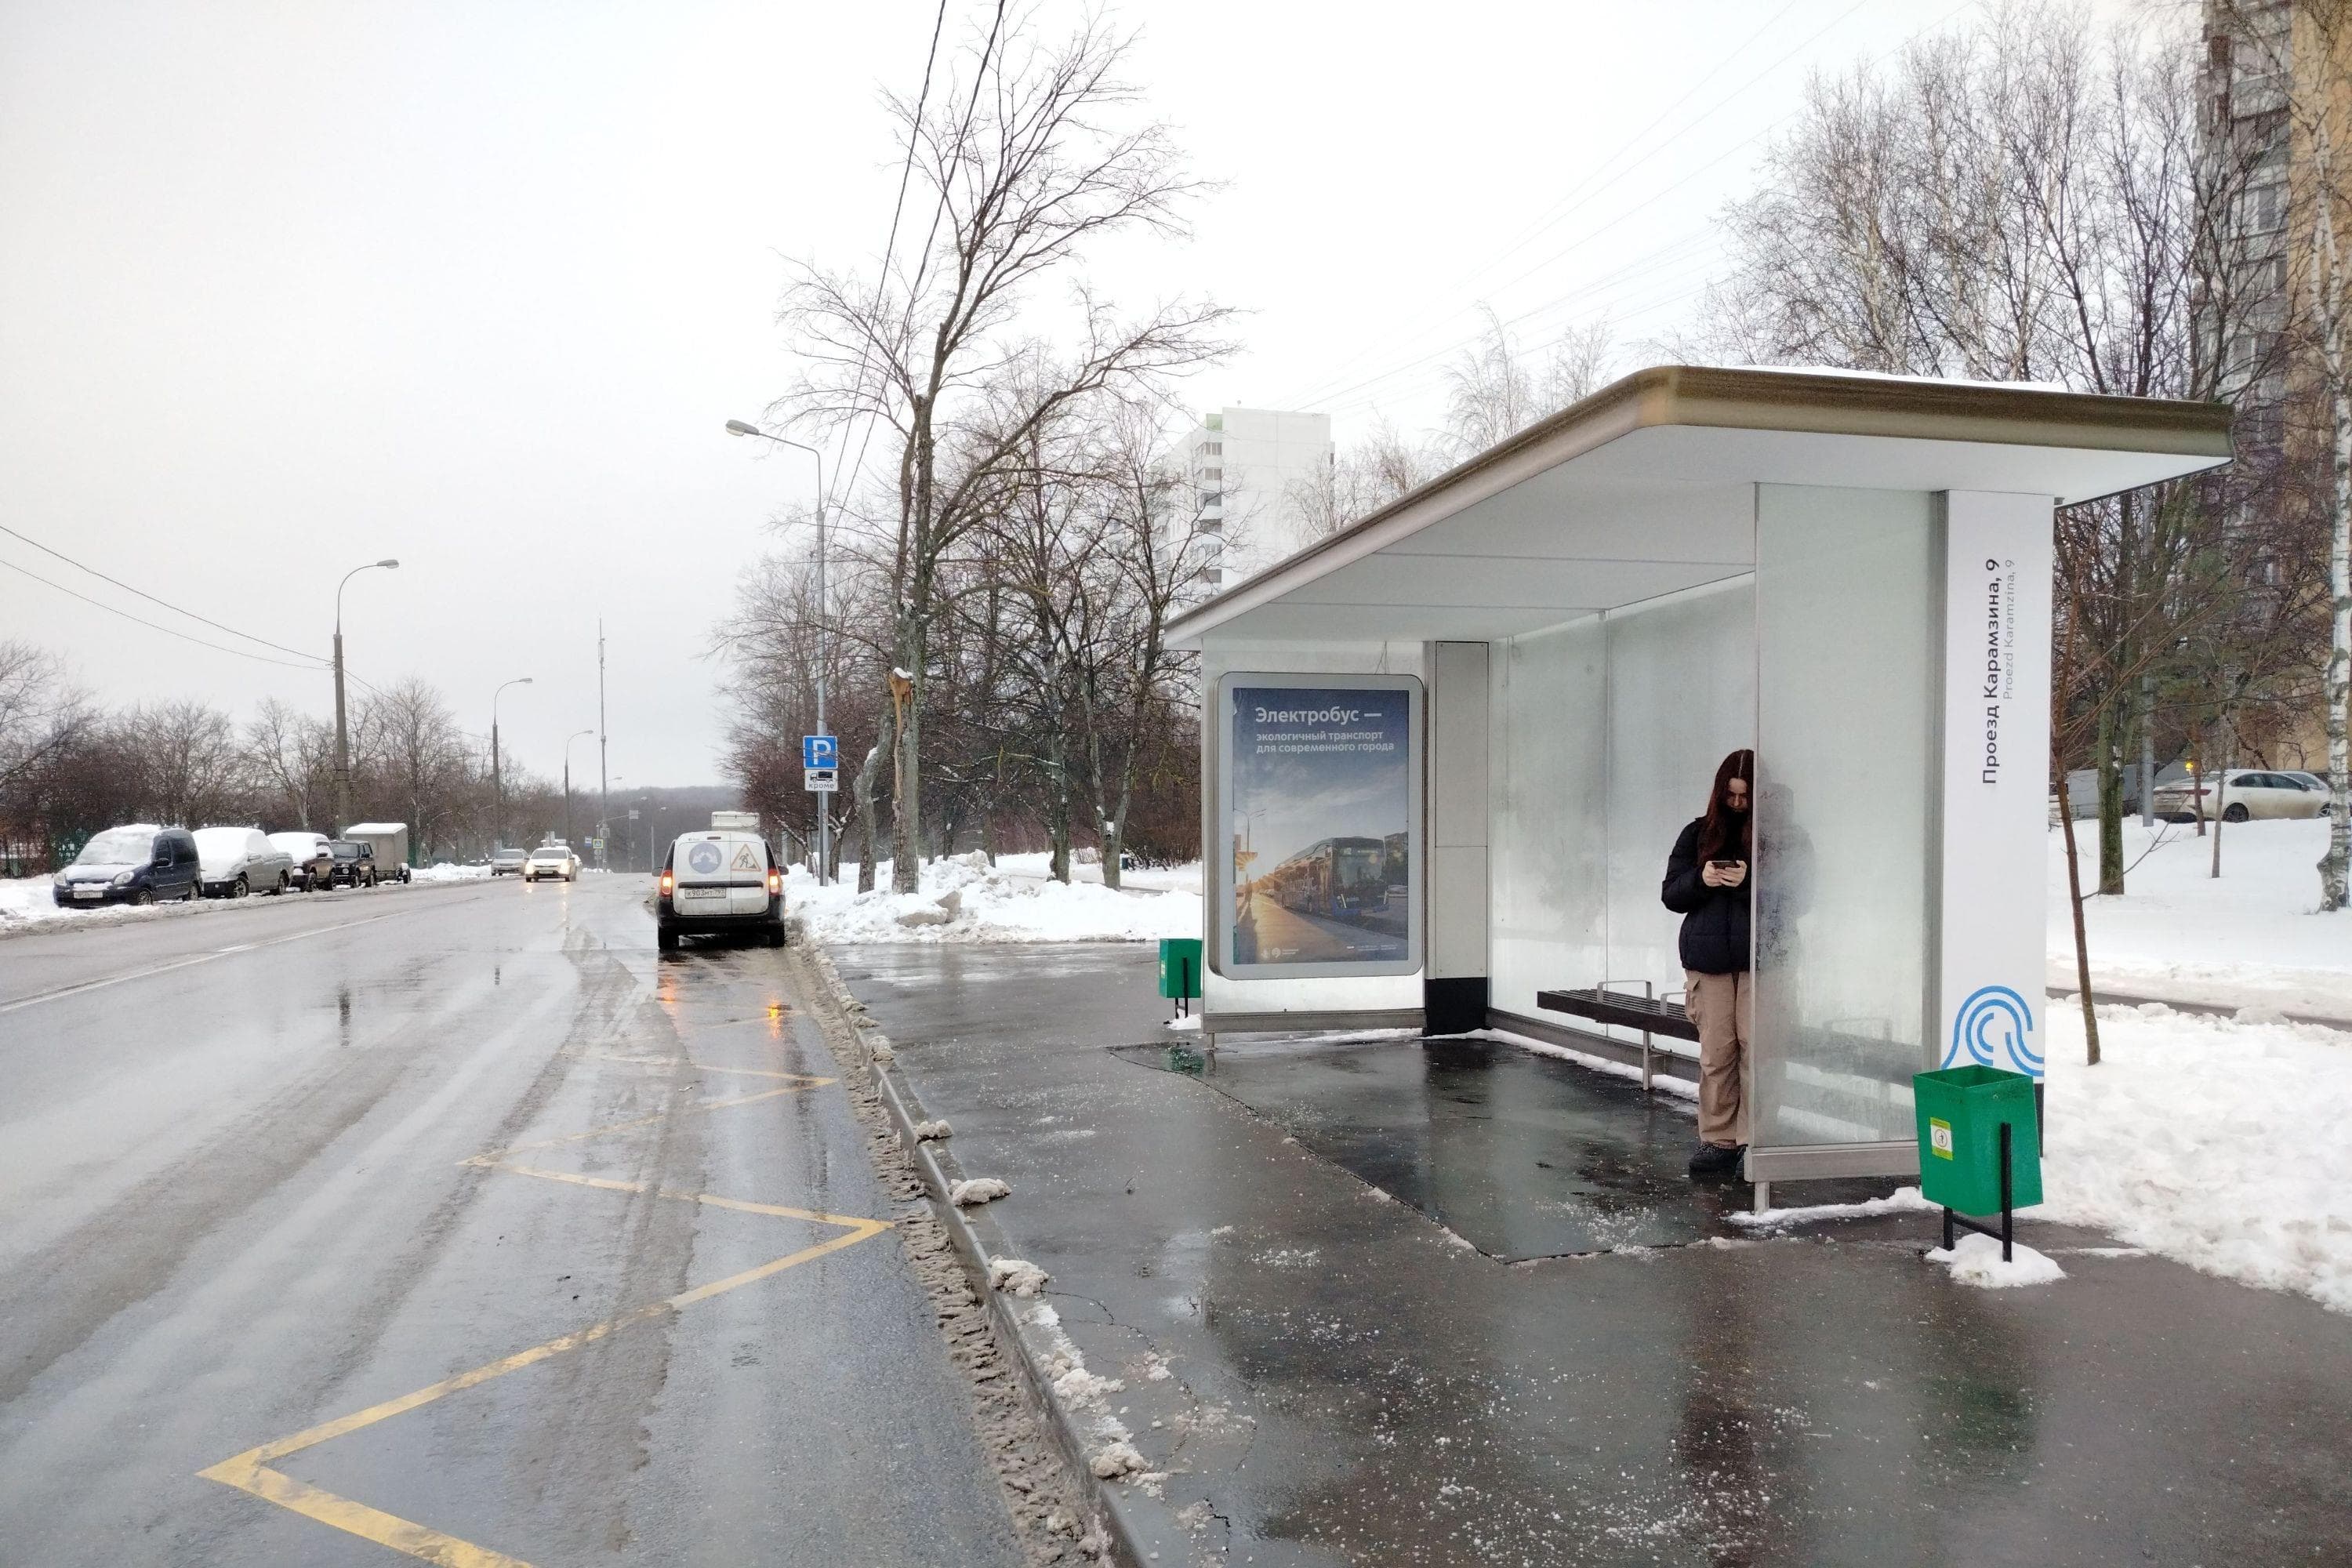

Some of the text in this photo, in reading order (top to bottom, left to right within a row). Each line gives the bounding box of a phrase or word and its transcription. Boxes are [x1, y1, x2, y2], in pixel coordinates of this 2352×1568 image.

[2003, 559, 2016, 699] Proezd Karamzina, 9
[1983, 558, 2002, 784] Проезд Карамзина, 9
[1255, 706, 1359, 726] Электробус
[1256, 730, 1383, 742] экологичный транспорт
[813, 739, 831, 765] P
[1256, 742, 1395, 755] для современного города
